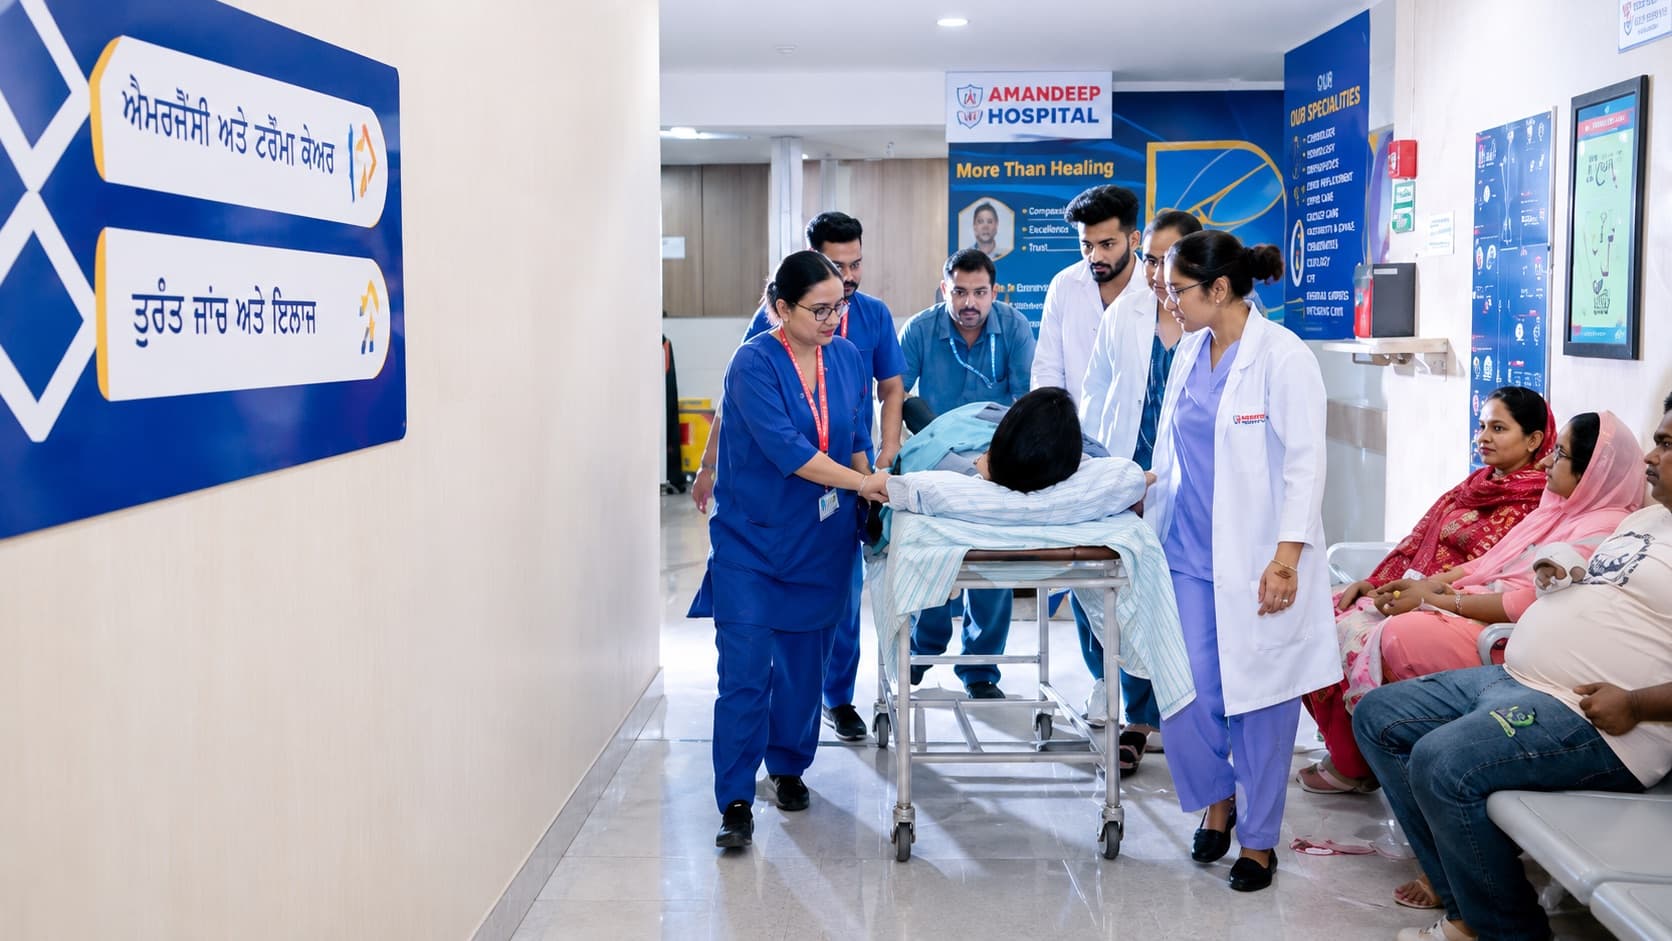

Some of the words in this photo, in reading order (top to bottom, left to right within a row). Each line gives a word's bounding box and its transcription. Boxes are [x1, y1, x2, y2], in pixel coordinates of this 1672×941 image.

[988, 86, 1101, 102] AMANDEEP
[1307, 85, 1361, 121] SPECIALITIES
[122, 74, 210, 147] ਐਮਰਜੈਂਸੀ
[217, 106, 248, 154] ਅਤੇ
[300, 123, 335, 174] ਕੇਅਰ
[988, 107, 1099, 124] HOSPITAL
[956, 162, 1000, 178] More
[1004, 161, 1046, 177] Than
[1051, 159, 1114, 178] Healing
[132, 277, 184, 348] ਤੁਰੰਤ
[193, 285, 228, 334] ਜਾਂਚ
[236, 285, 265, 334] ਅਤੇ
[272, 286, 316, 334] ਇਲਾਜ
